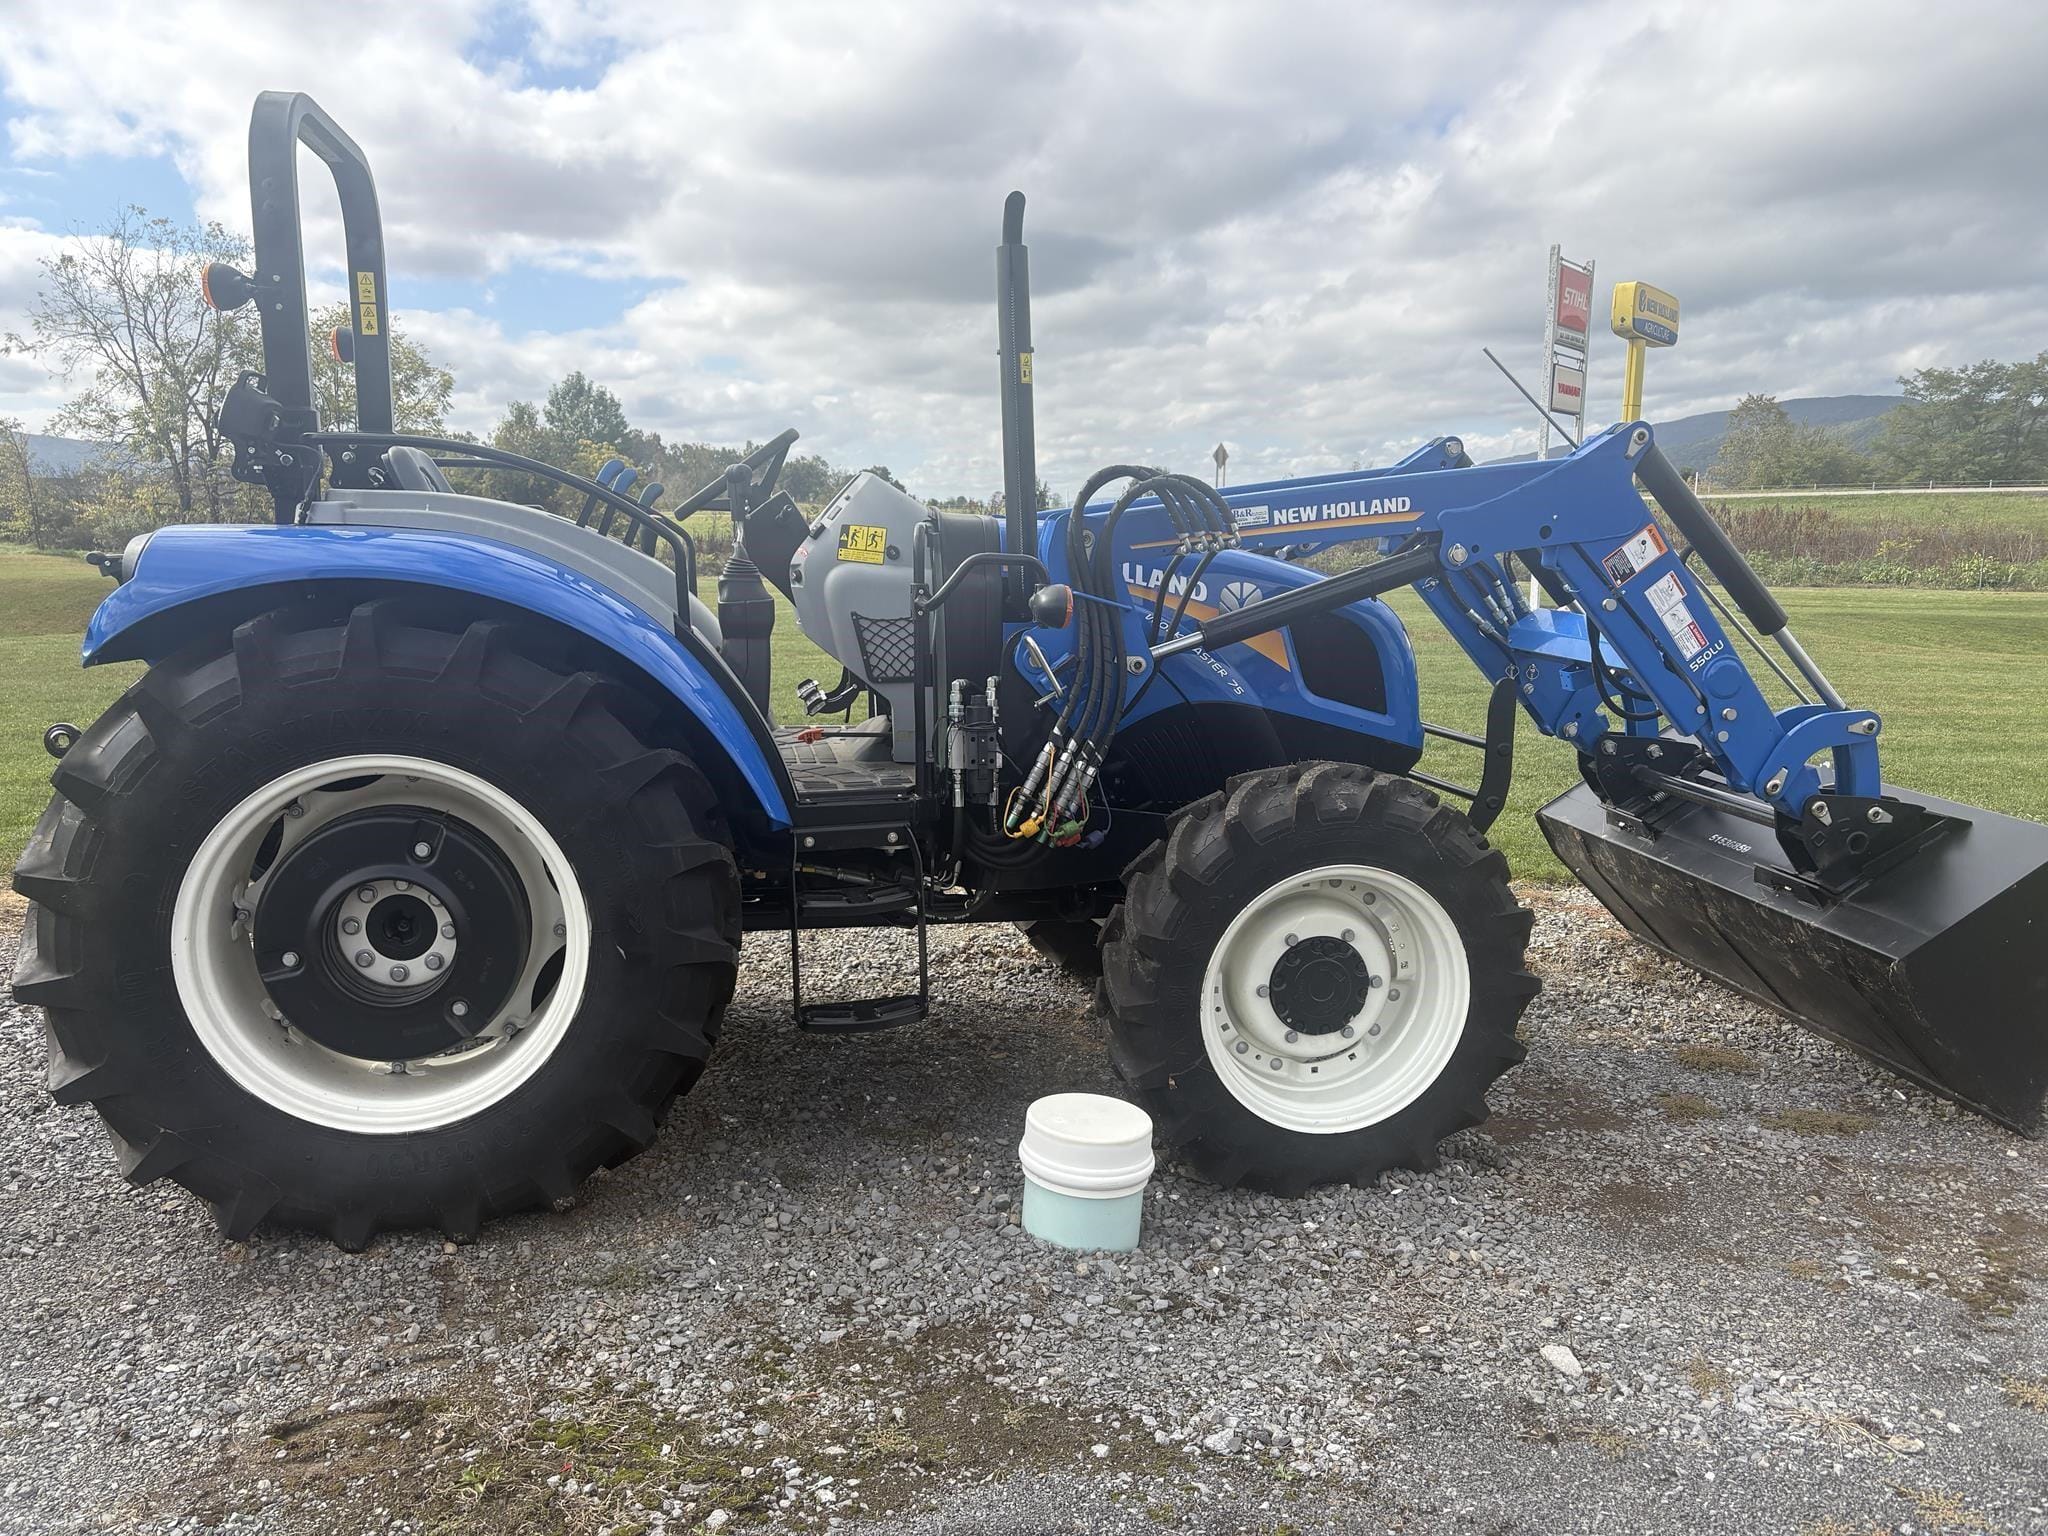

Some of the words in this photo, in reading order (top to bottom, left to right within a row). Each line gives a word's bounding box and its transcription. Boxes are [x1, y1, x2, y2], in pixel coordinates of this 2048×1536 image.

[1563, 287, 1588, 311] STIHL
[1273, 505, 1317, 525] NEW
[1322, 496, 1411, 519] HOLLAND
[1689, 639, 1724, 673] 550LU
[1227, 679, 1245, 696] 75
